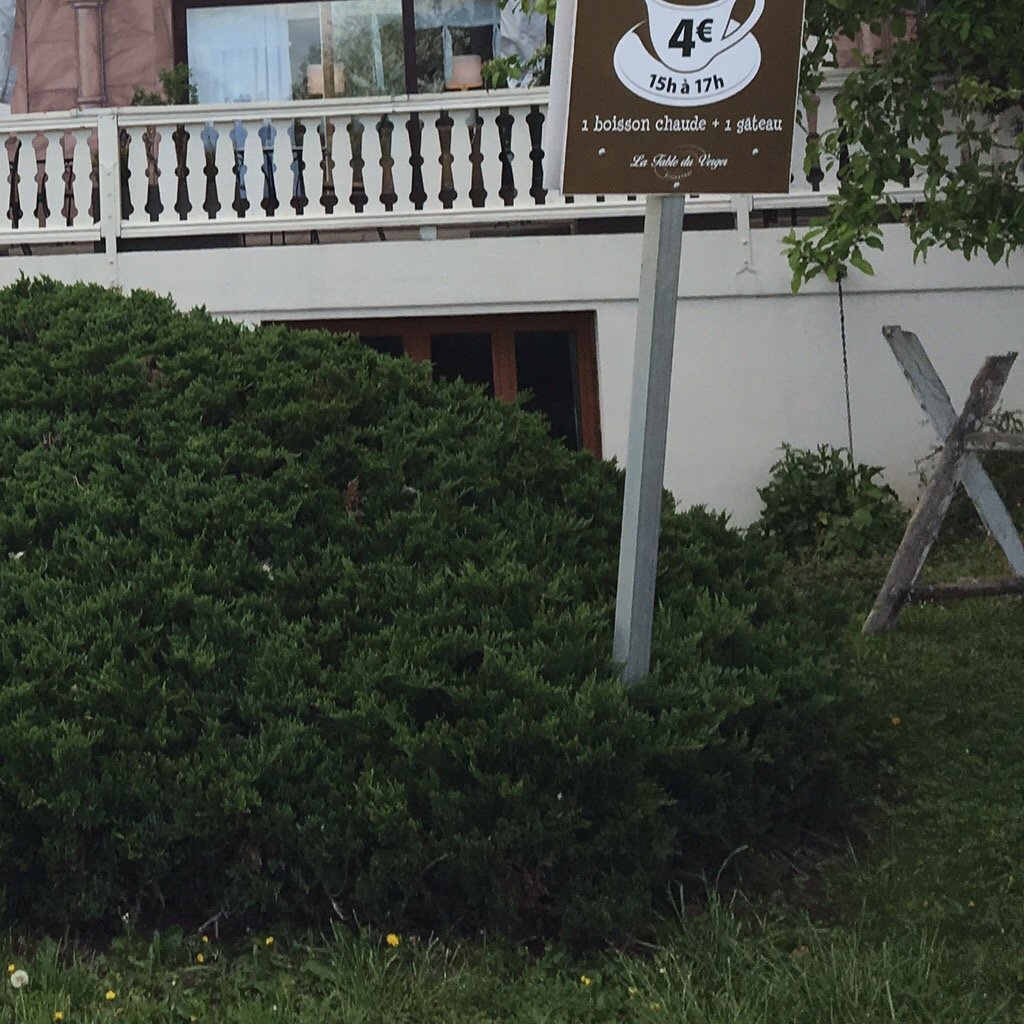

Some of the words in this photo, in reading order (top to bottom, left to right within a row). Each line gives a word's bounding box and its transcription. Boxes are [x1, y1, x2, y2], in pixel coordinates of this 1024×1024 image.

[668, 18, 714, 58] 4€
[649, 74, 677, 93] 15h
[680, 78, 690, 94] à
[695, 74, 725, 94] 17h
[581, 119, 589, 132] 1
[593, 114, 650, 132] boisson
[655, 114, 706, 132] chaude
[724, 119, 732, 132] 1
[736, 114, 783, 134] gâteau
[630, 154, 647, 168] La
[651, 153, 679, 168] Table
[680, 154, 694, 167] du
